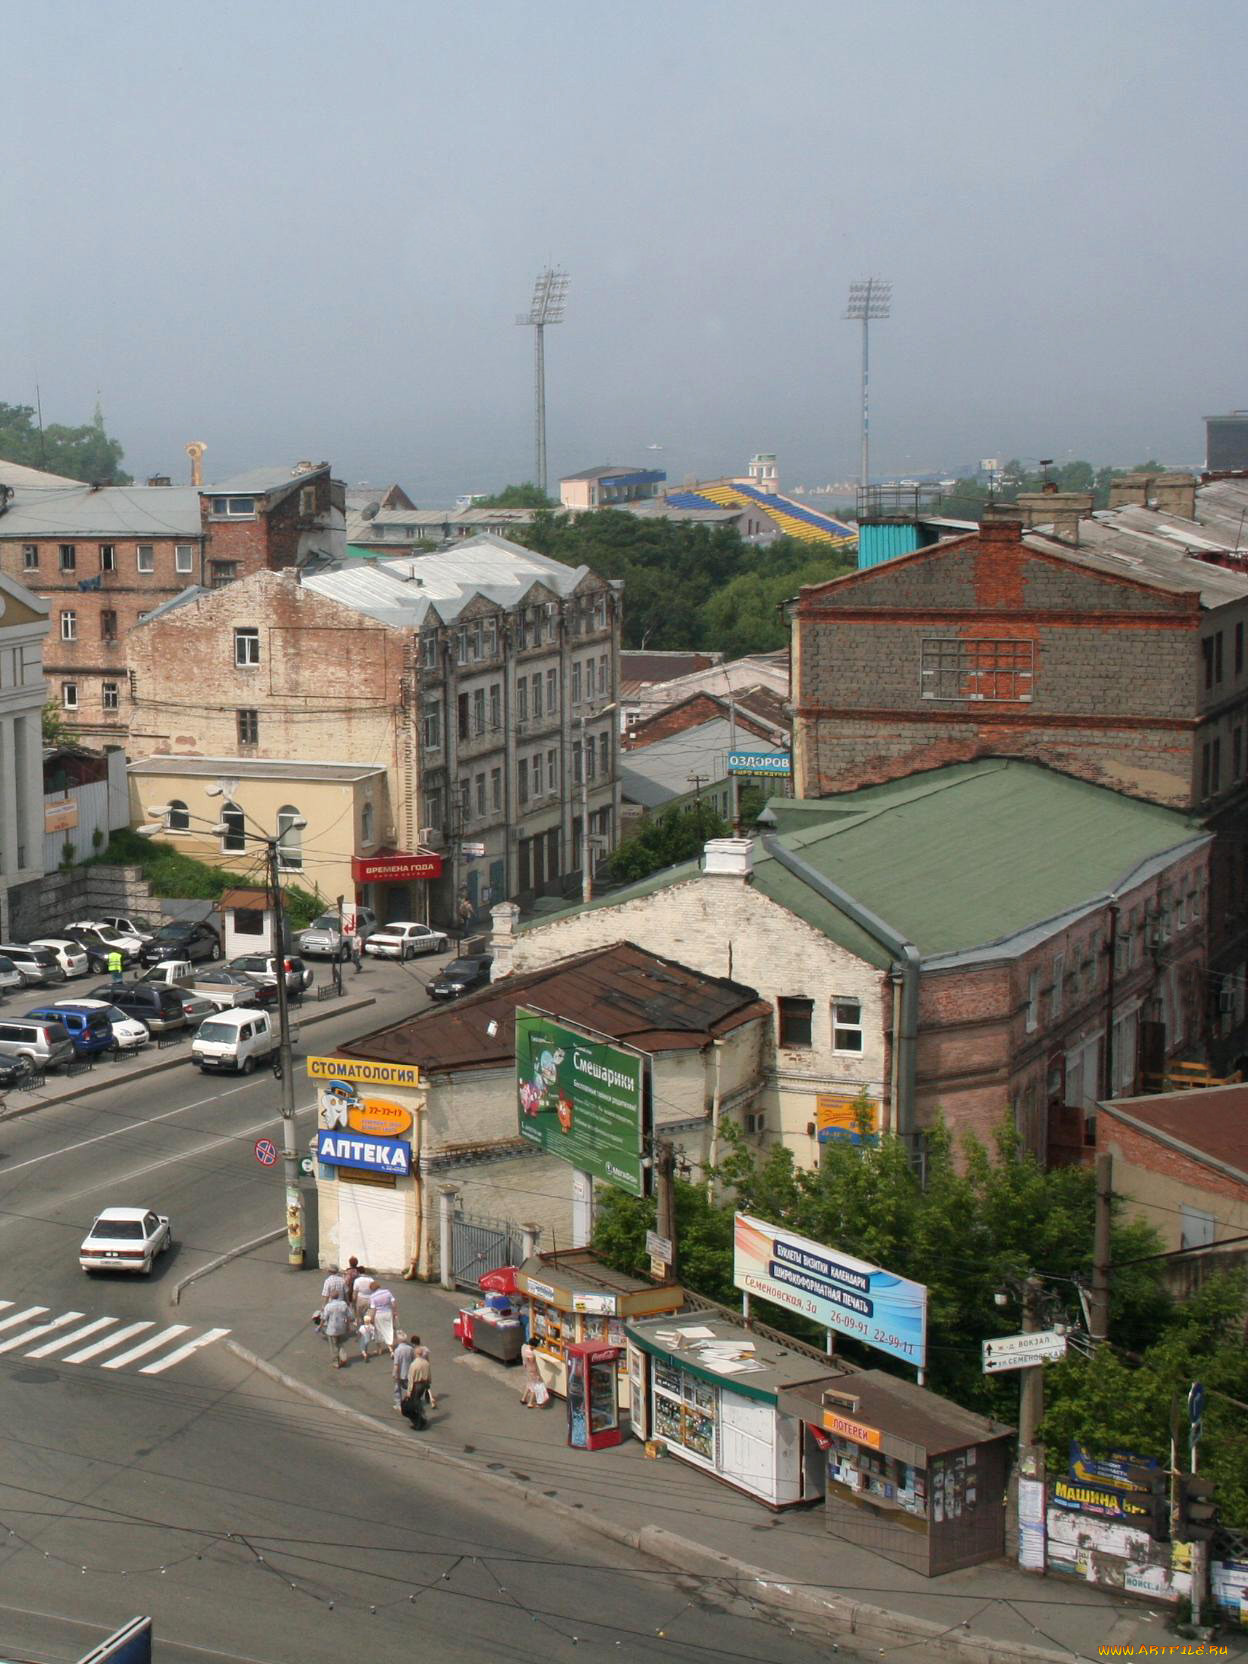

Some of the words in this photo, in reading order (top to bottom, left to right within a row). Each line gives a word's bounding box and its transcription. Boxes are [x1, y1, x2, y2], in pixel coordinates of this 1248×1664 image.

[366, 865, 409, 874] ВРЕМЕНА
[411, 863, 435, 872] ГОДА
[311, 1061, 415, 1082] СТОМАТОЛОГИЯ
[573, 1052, 635, 1092] Смешарики
[320, 1138, 407, 1167] АПТЕКА
[777, 1244, 802, 1264] БУКЛЕТЫ
[803, 1254, 828, 1273] ВИЗИТКИ
[830, 1264, 866, 1290] КАЛЕНДАРИ
[773, 1264, 841, 1302] ШИРОКОФОРМАТНАЯ
[842, 1292, 869, 1313] ПЕЧАТЬ
[831, 1310, 869, 1335] 26-09-91
[874, 1328, 914, 1356] 22-99-11
[1055, 1481, 1118, 1508] МАШИНА
